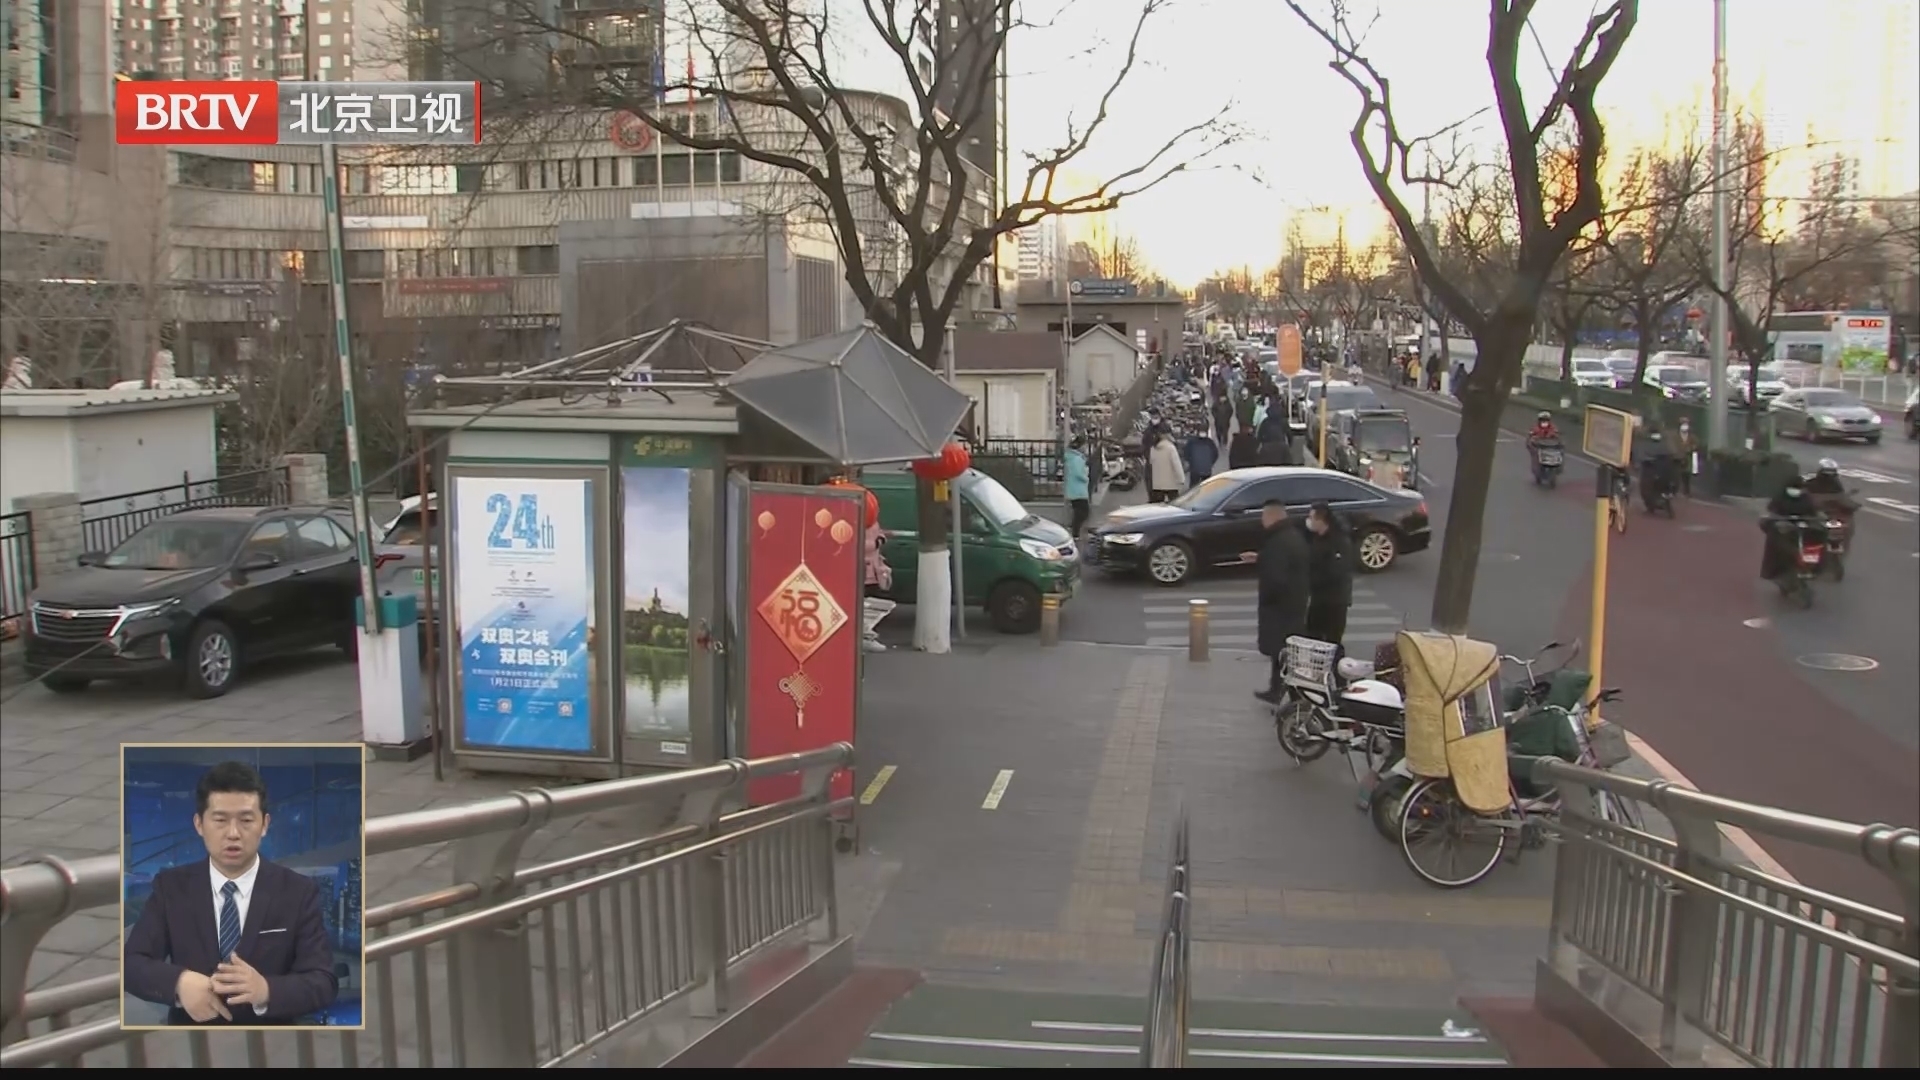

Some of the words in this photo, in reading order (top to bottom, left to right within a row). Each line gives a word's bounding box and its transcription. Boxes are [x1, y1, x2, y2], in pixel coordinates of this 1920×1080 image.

[486, 493, 555, 549] 24th
[781, 589, 822, 642] 福
[481, 627, 550, 646] 双奥之城
[499, 648, 569, 666] 双奥会刊
